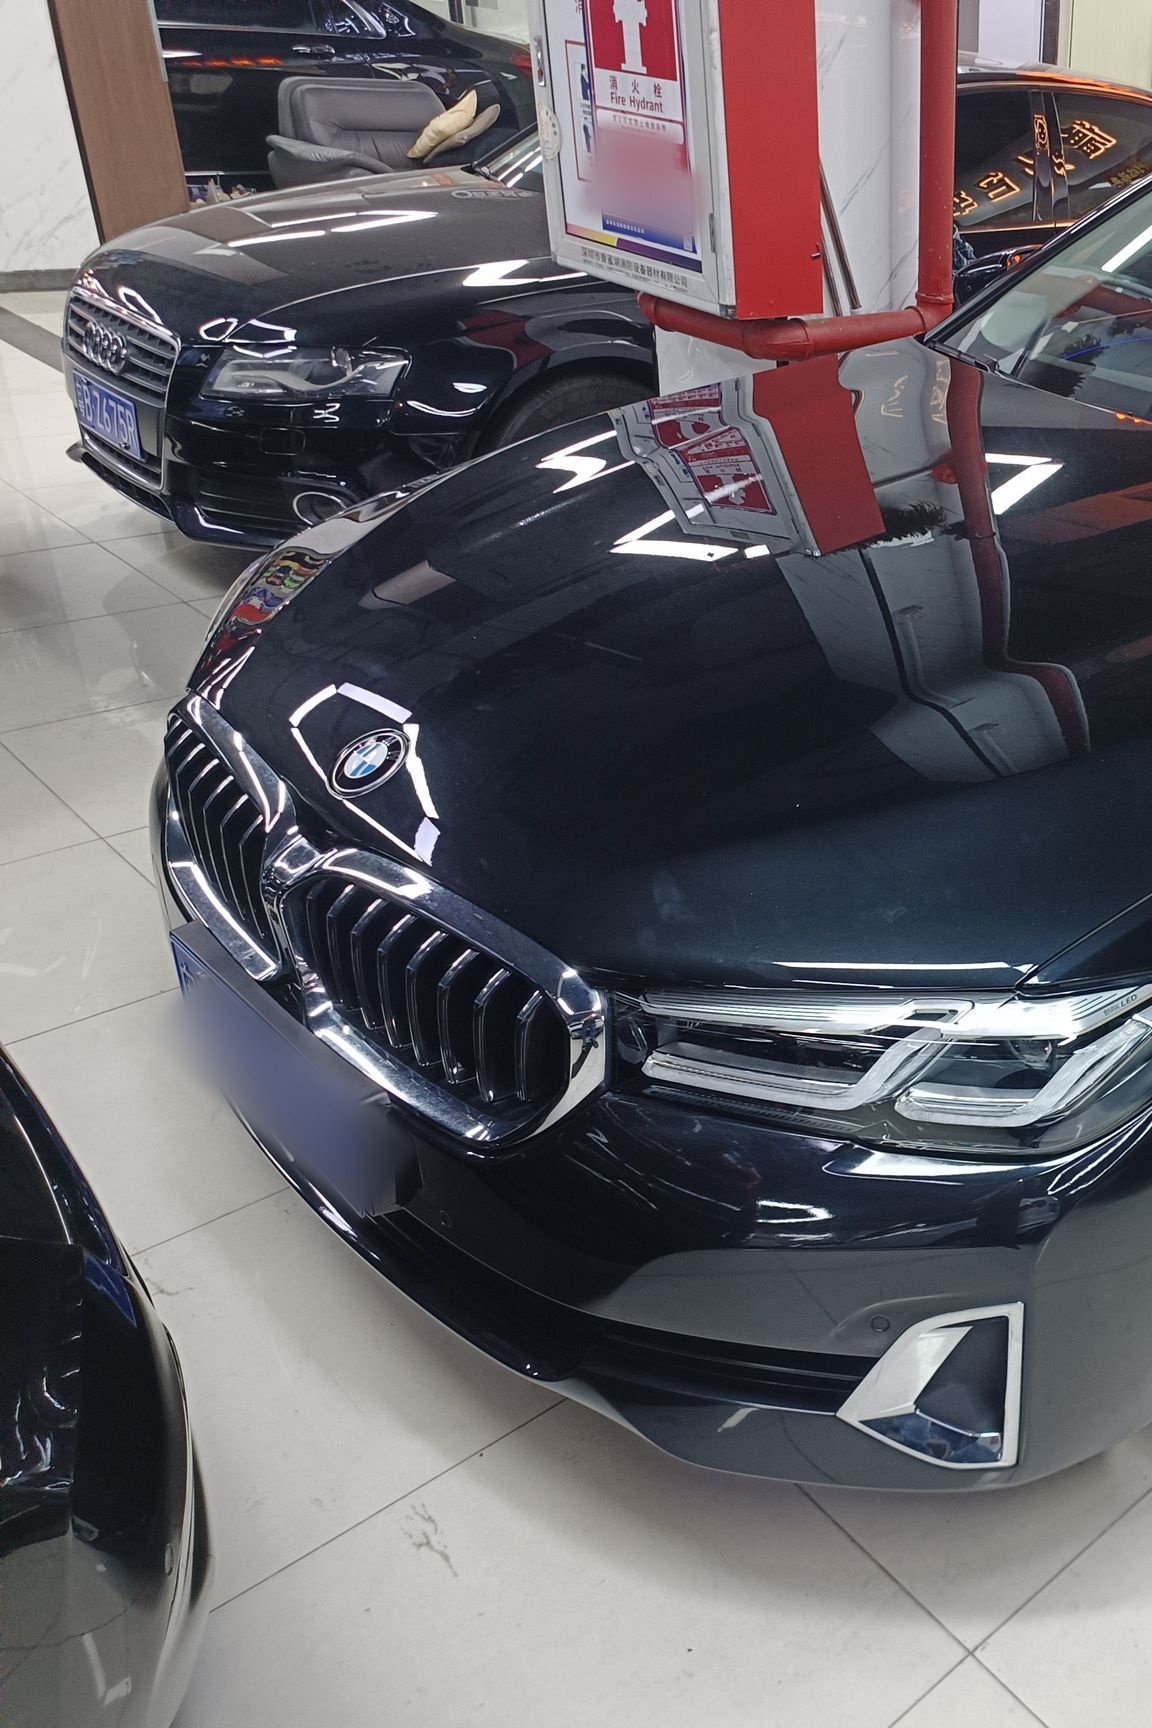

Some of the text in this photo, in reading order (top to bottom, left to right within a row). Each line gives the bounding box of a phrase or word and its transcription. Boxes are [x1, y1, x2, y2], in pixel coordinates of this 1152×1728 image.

[609, 75, 663, 98] 消火栓
[610, 91, 664, 113] Fire Hydrant
[1120, 994, 1137, 1007] LED
